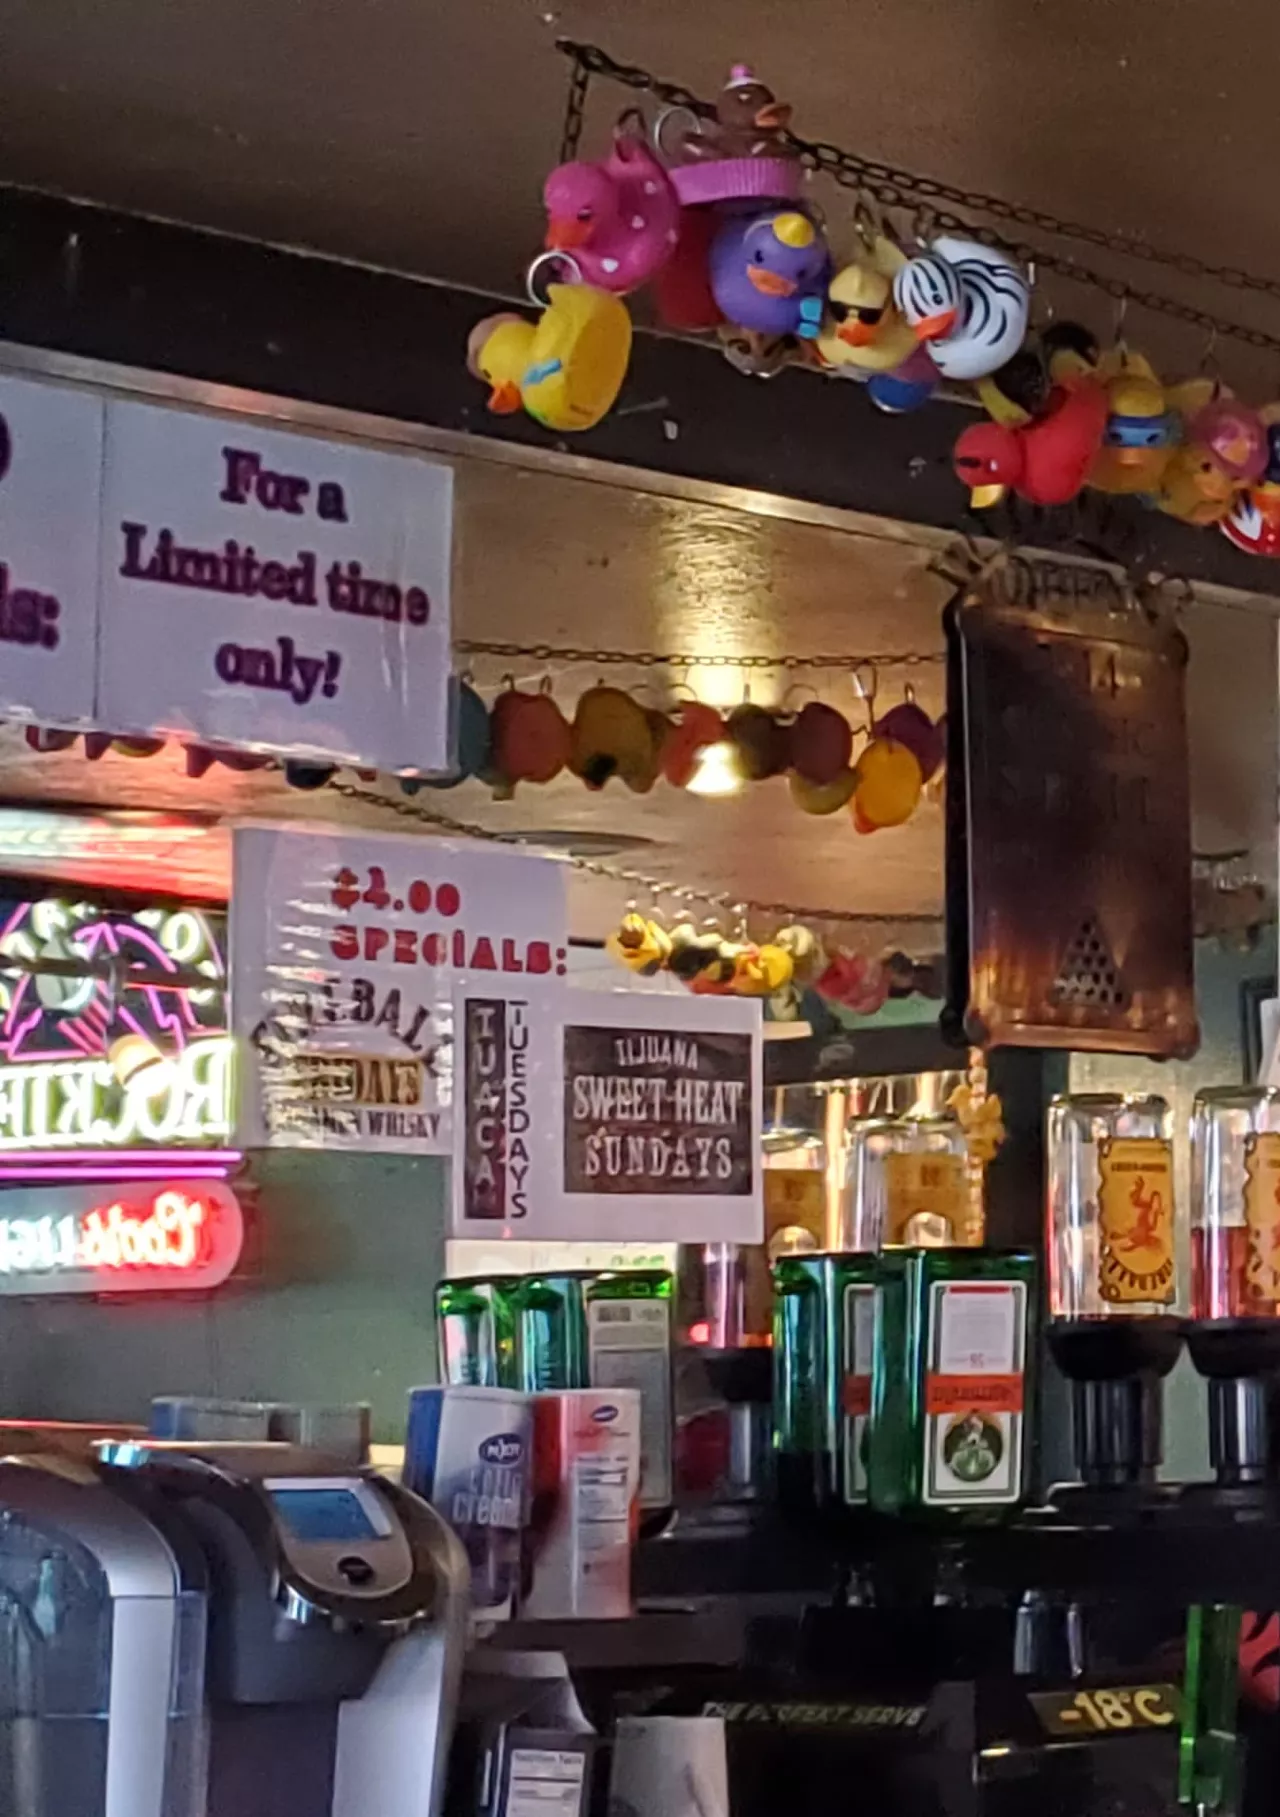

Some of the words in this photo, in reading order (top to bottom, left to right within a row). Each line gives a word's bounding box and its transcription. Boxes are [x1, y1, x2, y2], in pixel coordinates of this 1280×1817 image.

[220, 446, 310, 514] For
[317, 482, 348, 523] a
[120, 521, 317, 606] Limited
[326, 560, 429, 626] time
[215, 636, 341, 705] only!
[330, 924, 567, 976] SPECIALS:
[509, 1001, 530, 1219] TUESDAYS
[674, 1080, 744, 1125] HEAT
[584, 1134, 733, 1179] SUNDAYS
[1058, 1690, 1175, 1730] -18°C
